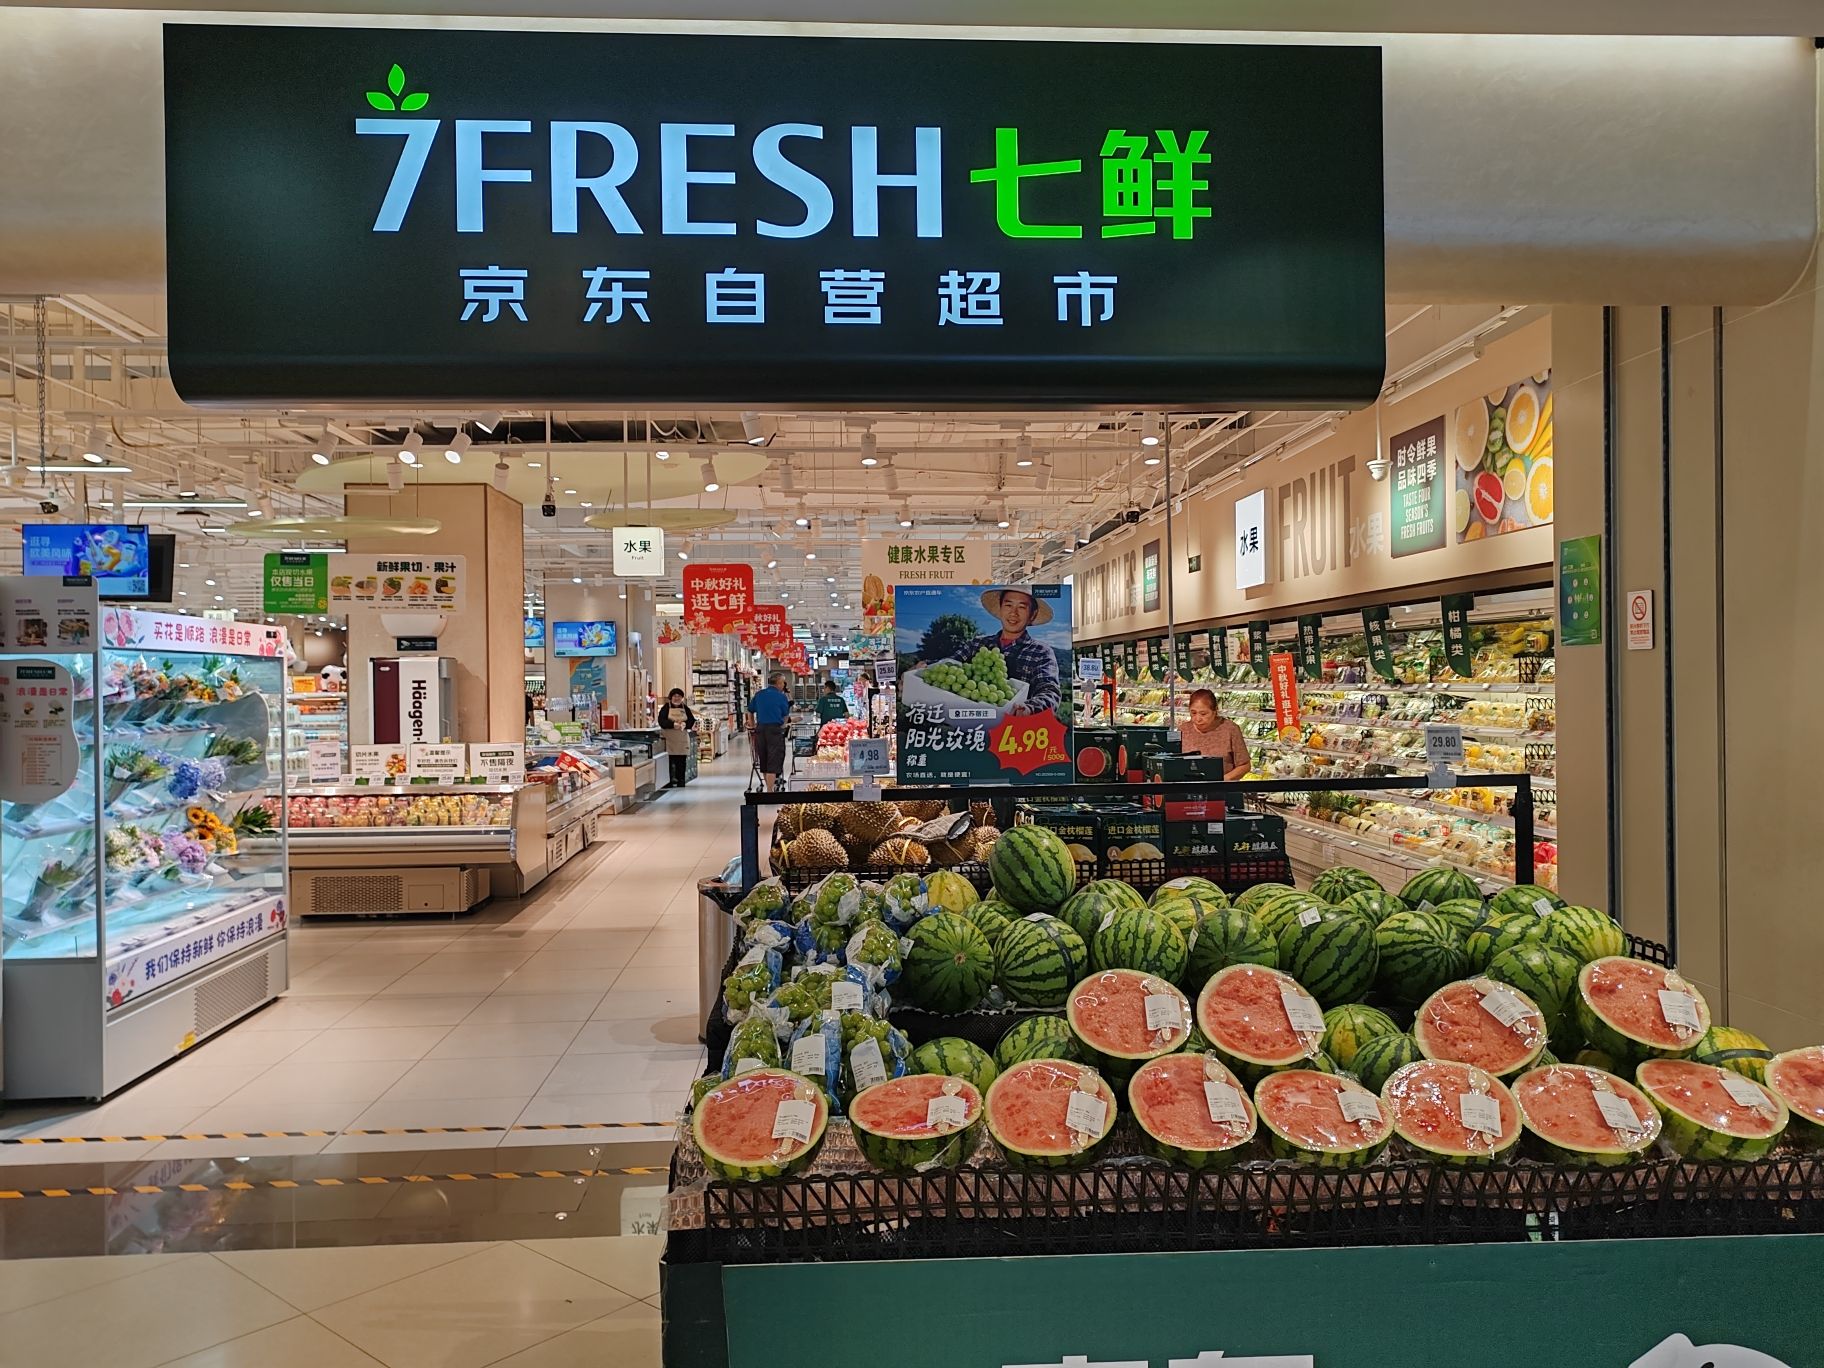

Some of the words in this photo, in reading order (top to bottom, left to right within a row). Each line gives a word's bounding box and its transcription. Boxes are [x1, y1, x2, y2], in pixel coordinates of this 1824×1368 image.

[354, 117, 944, 240] 7FRESH
[969, 126, 1213, 242] 七鲜
[459, 265, 1119, 328] 京东自营超市
[1397, 434, 1437, 468] 时令鲜果
[1397, 458, 1437, 492] 品味四季
[1403, 490, 1418, 508] TASTE
[1418, 486, 1431, 504] FOUR
[1278, 454, 1356, 583] FRUIT
[1400, 523, 1416, 540] FRESH
[1416, 519, 1434, 536] FRUITS
[623, 539, 652, 553] 水果
[887, 545, 966, 565] 健康水果专区
[1239, 525, 1259, 556] 水果
[270, 576, 315, 587] 仅售当日
[690, 577, 747, 592] 中秋好礼
[899, 570, 927, 579] FRESH
[927, 570, 955, 579] FRUIT
[1079, 549, 1137, 627] VEGETABLES
[690, 593, 748, 615] 逛七鲜
[153, 621, 205, 643] 买花是顺路
[209, 627, 252, 647] 浪漫是日常
[1253, 630, 1263, 664] 浆果类
[1303, 625, 1316, 665] 热带水果
[1369, 620, 1386, 661] 核果类
[1448, 609, 1465, 657] 柑橘类
[1277, 664, 1291, 699] 中秋好礼
[408, 680, 427, 744] Häagen-
[905, 701, 945, 725] 宿迁
[905, 723, 986, 752] 阳光玫瑰
[998, 725, 1049, 755] 4.98
[1432, 736, 1456, 748] 29.80
[859, 749, 879, 761] 4.98
[905, 753, 928, 767] 称重
[1107, 824, 1161, 836] 进口金枕榴莲
[144, 933, 214, 981] 我们保持新鲜
[216, 912, 264, 948] 你保持浪漫
